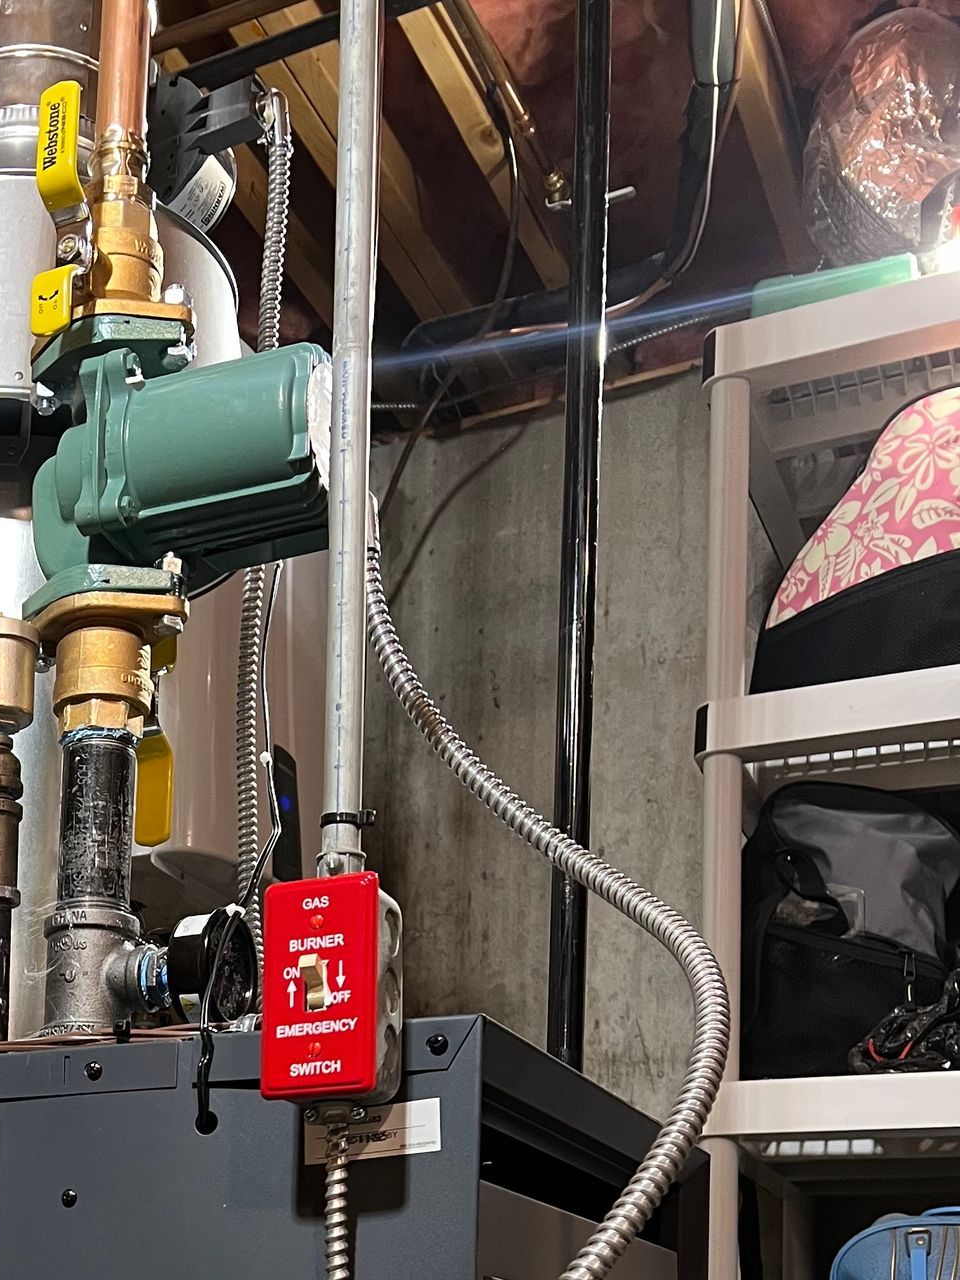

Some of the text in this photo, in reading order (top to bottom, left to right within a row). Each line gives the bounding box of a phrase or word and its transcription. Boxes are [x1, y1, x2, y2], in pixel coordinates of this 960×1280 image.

[43, 102, 60, 172] Webstone
[302, 896, 329, 910] GAS
[289, 934, 344, 952] BURNER
[283, 967, 301, 980] ON
[332, 990, 351, 1004] OFF
[276, 1017, 358, 1038] EMERGENCY
[290, 1060, 341, 1077] SWITCH
